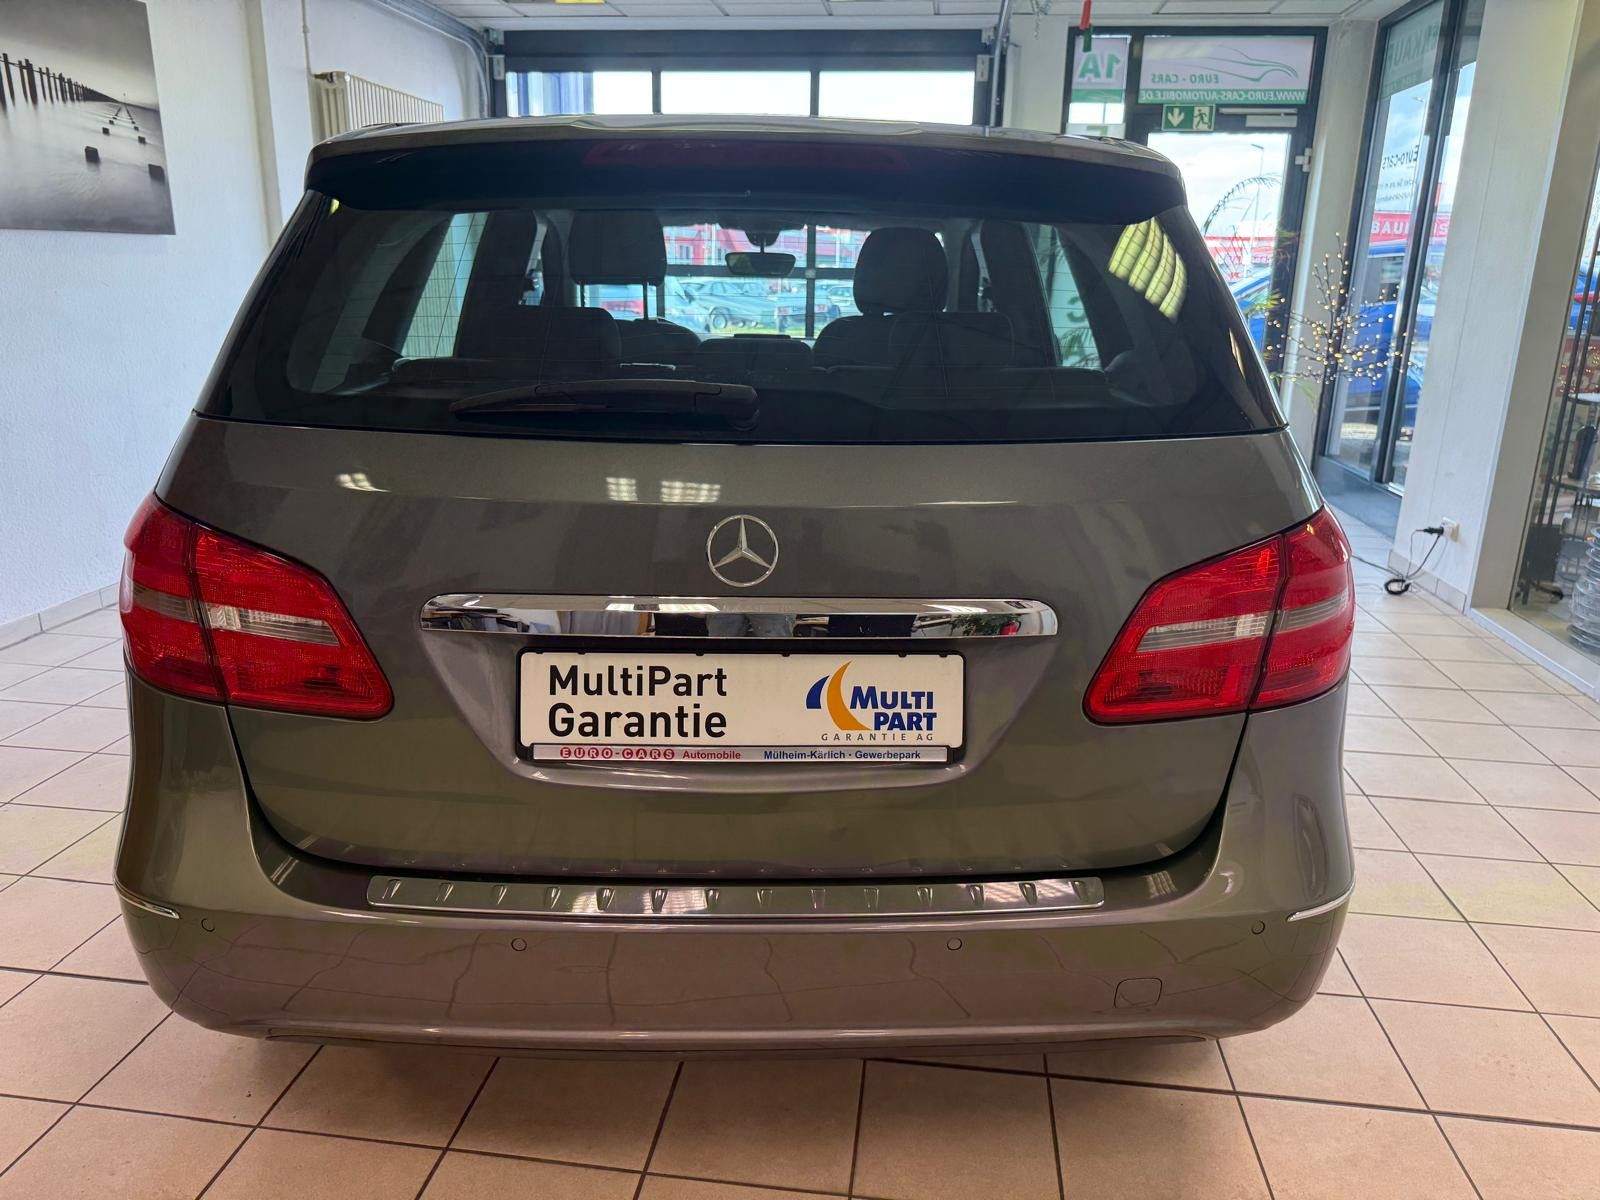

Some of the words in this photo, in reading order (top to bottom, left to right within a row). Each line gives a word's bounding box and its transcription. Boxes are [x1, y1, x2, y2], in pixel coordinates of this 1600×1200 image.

[549, 665, 727, 697] MultiPart
[850, 686, 934, 709] MULTI
[548, 703, 727, 738] Garantie
[874, 712, 937, 731] PART
[821, 733, 907, 741] GARANTIE
[916, 733, 933, 741] AG
[560, 747, 675, 760] EURO-CARS
[682, 749, 741, 760] Automobile
[764, 749, 846, 760] Mülheim-Kärlich
[855, 749, 921, 761] Gewerbepark
